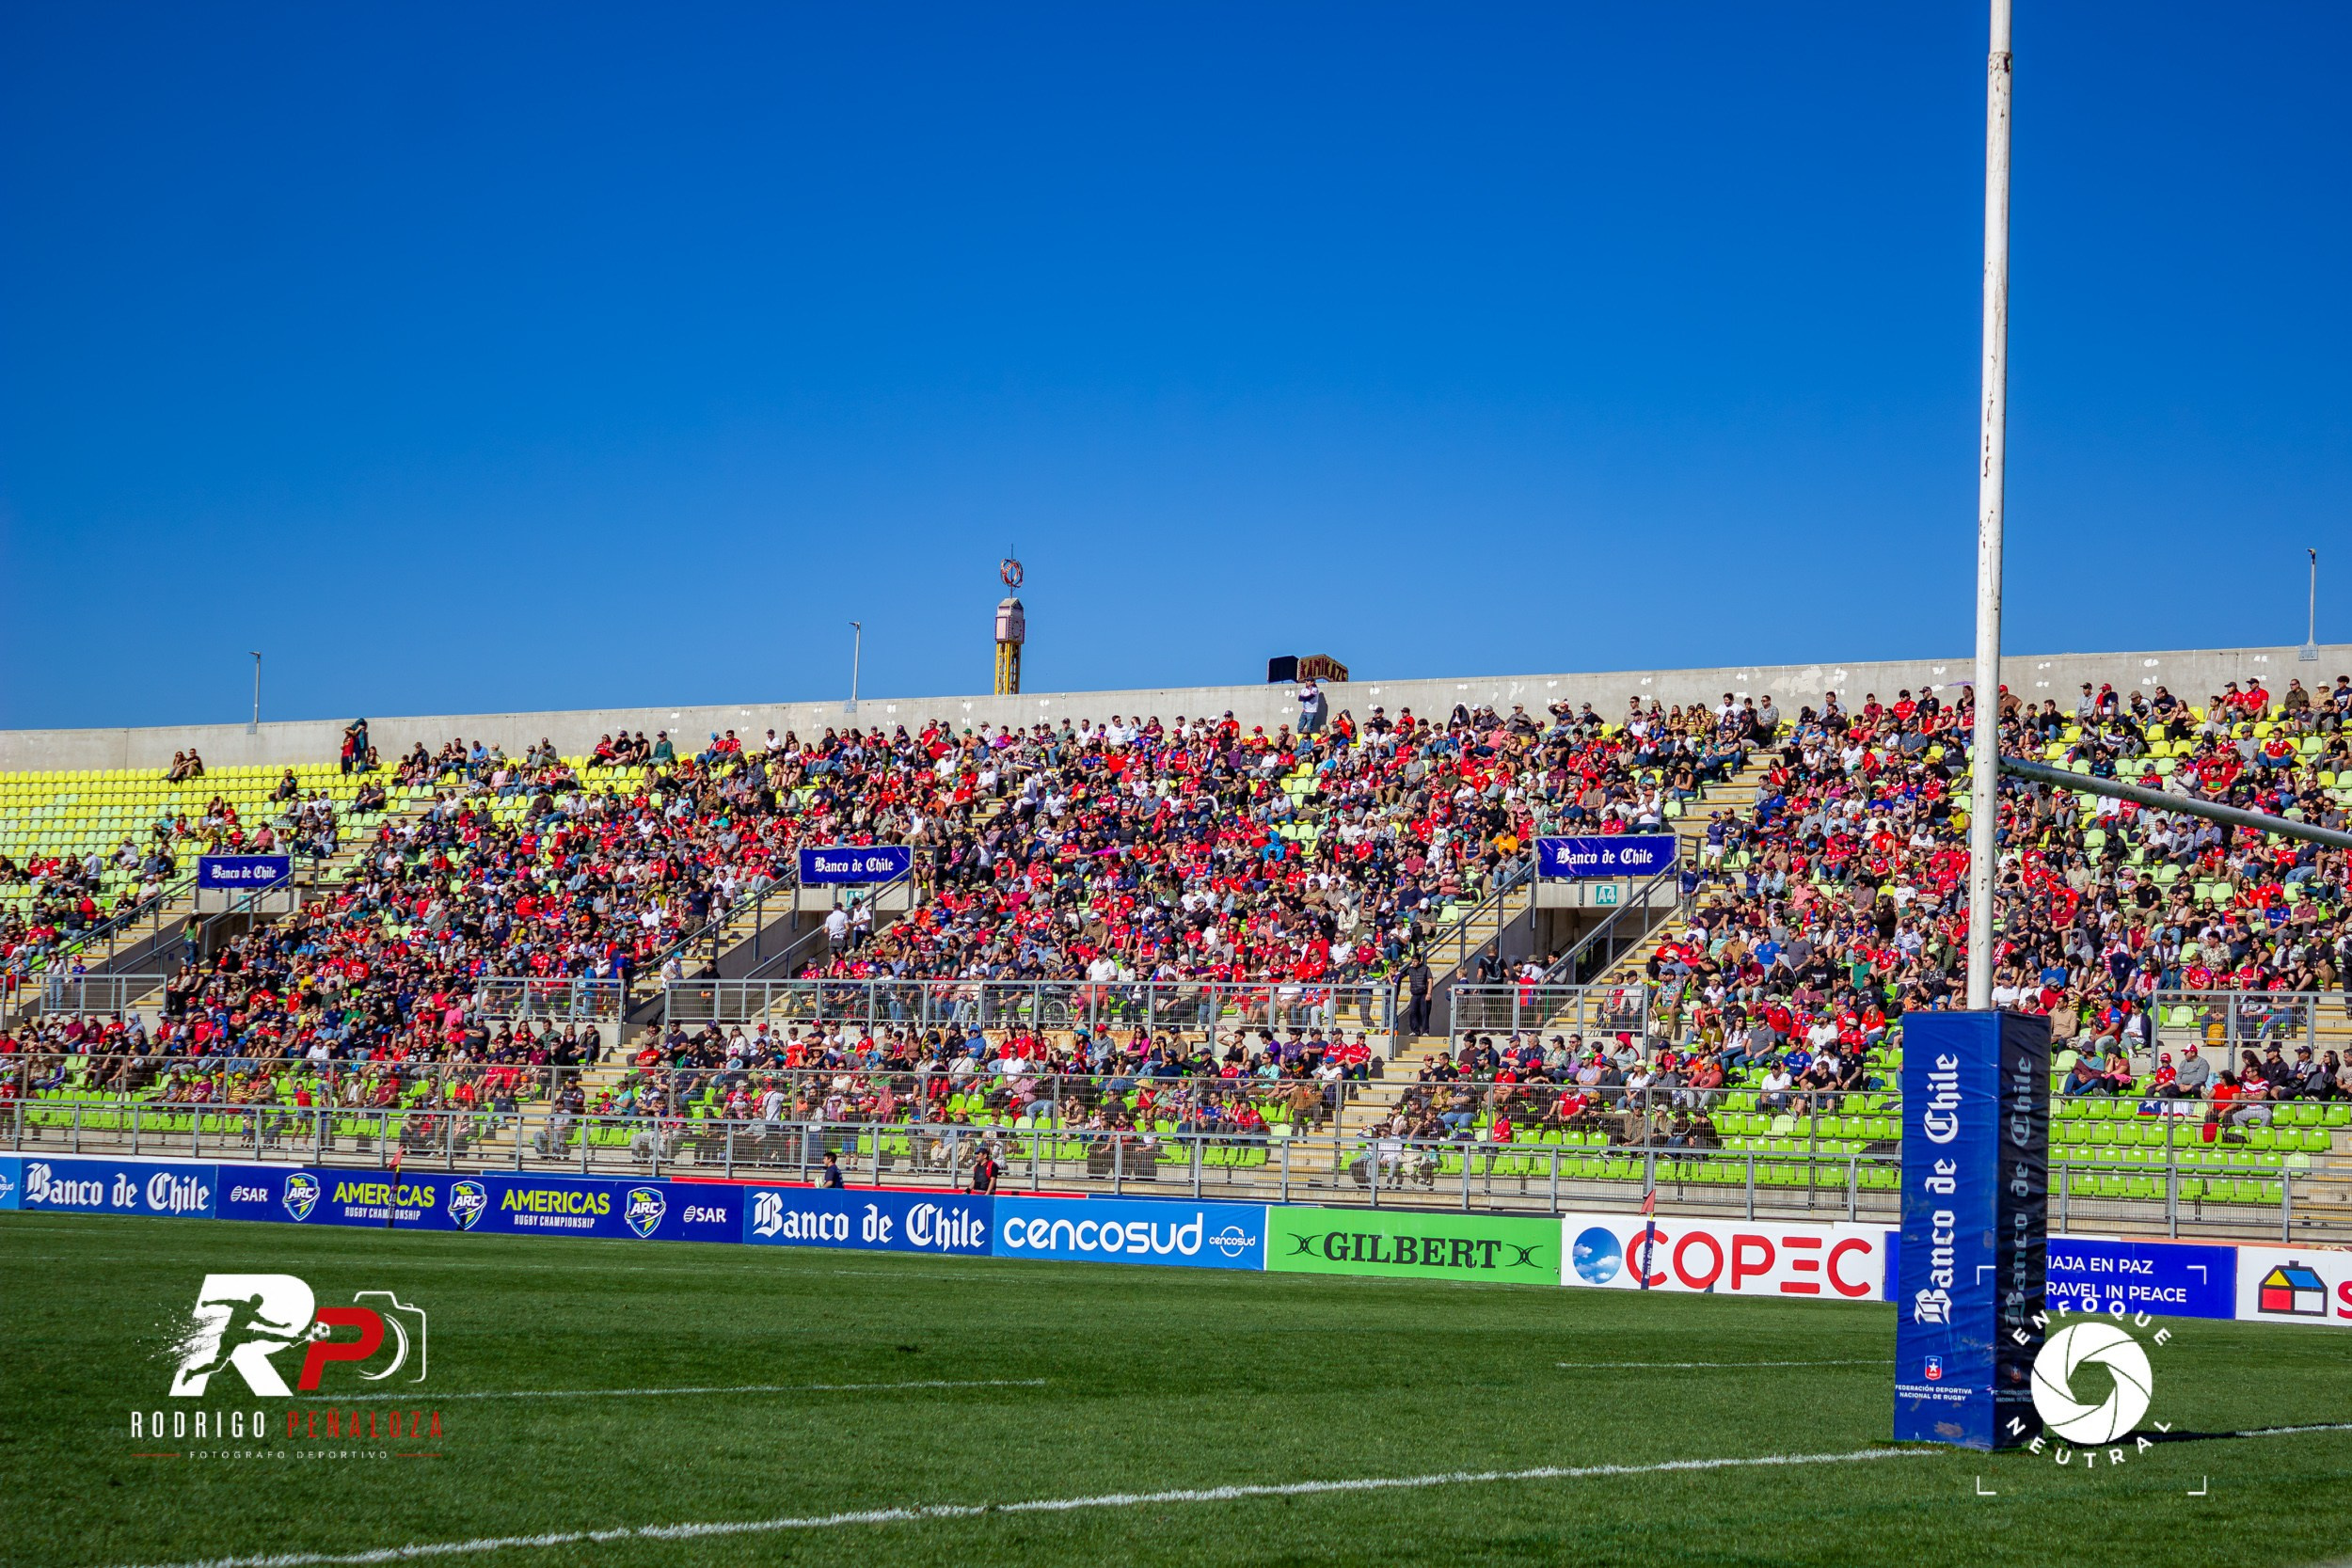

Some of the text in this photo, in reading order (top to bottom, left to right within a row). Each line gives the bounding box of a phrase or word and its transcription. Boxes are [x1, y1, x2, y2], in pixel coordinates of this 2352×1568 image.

[1300, 658, 1346, 681] KAMIKAZE
[815, 857, 894, 873] Banco de Chile
[1556, 847, 1653, 865] Banco de Chile
[212, 864, 277, 879] Banco de Chile
[1597, 886, 1615, 903] A4
[25, 1163, 210, 1214] Banco de Chile
[241, 1188, 267, 1202] SAR
[287, 1187, 314, 1200] ARC
[332, 1182, 436, 1208] AMERCAS
[1914, 1053, 1963, 1324] Banco de Chile
[2005, 1056, 2032, 1326] Banco de Chile
[453, 1194, 482, 1208] ARC
[501, 1189, 611, 1215] AMERICAS
[630, 1200, 661, 1215] ARC
[344, 1207, 421, 1221] RUGBY CHAMONSHIP
[514, 1214, 595, 1228] RUGBY CHAMPIONSHIP
[695, 1207, 726, 1223] SAR
[753, 1192, 985, 1252] Banco de Chile
[1003, 1212, 1203, 1256] cencosud
[1209, 1235, 1256, 1246] cencosud
[1323, 1231, 1502, 1269] GILBERT
[1626, 1230, 1872, 1297] COPEC
[2045, 1255, 2153, 1275] IAJA EN PAZ
[2045, 1281, 2187, 1303] RAVEL IN PEACE
[1895, 1385, 1934, 1393] FEDERACIÓN
